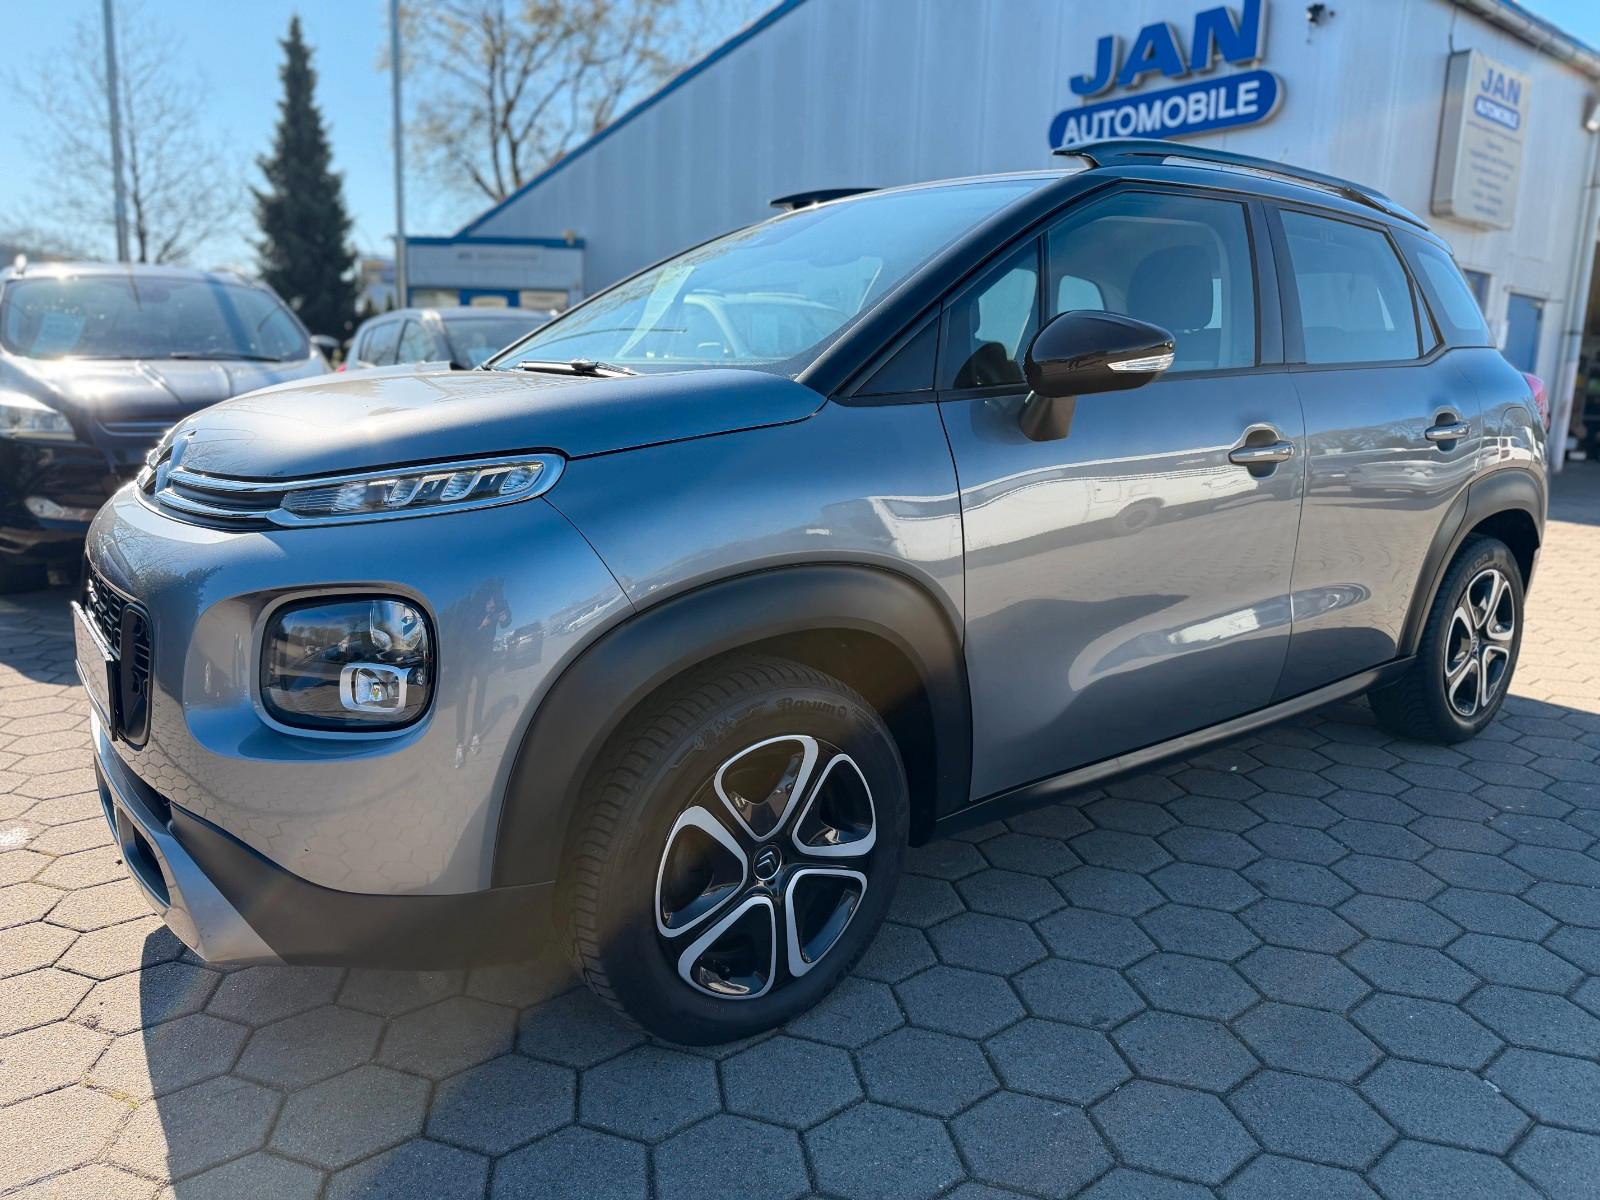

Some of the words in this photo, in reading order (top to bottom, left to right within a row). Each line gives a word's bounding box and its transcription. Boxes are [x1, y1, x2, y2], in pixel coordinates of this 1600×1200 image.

[1070, 0, 1262, 95] JAN
[1061, 79, 1261, 146] AUTOMOBILE
[1481, 68, 1521, 105] JAN
